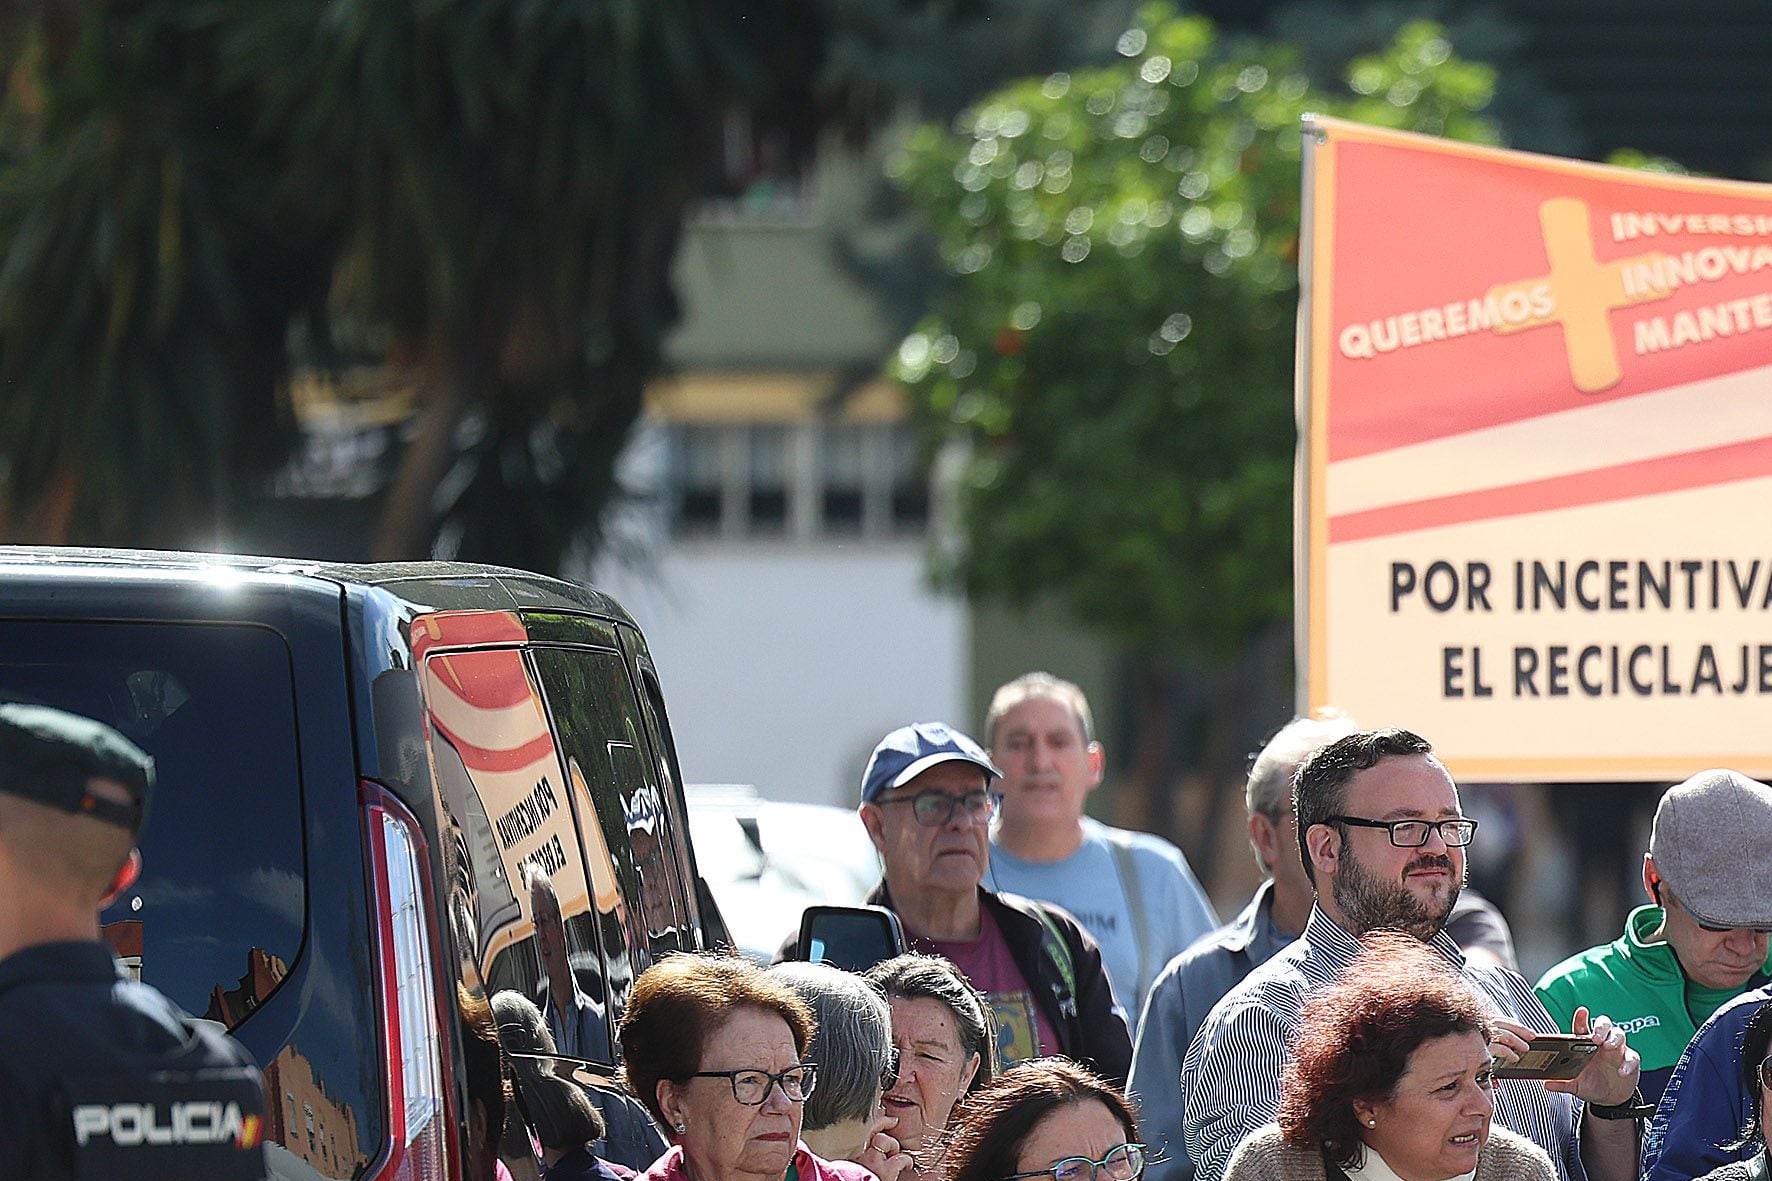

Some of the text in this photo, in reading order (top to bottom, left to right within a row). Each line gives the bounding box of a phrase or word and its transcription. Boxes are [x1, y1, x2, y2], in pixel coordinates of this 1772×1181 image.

[1339, 285, 1555, 359] QUEREMOS
[1389, 560, 1493, 613] POR
[1443, 645, 1493, 697] EL
